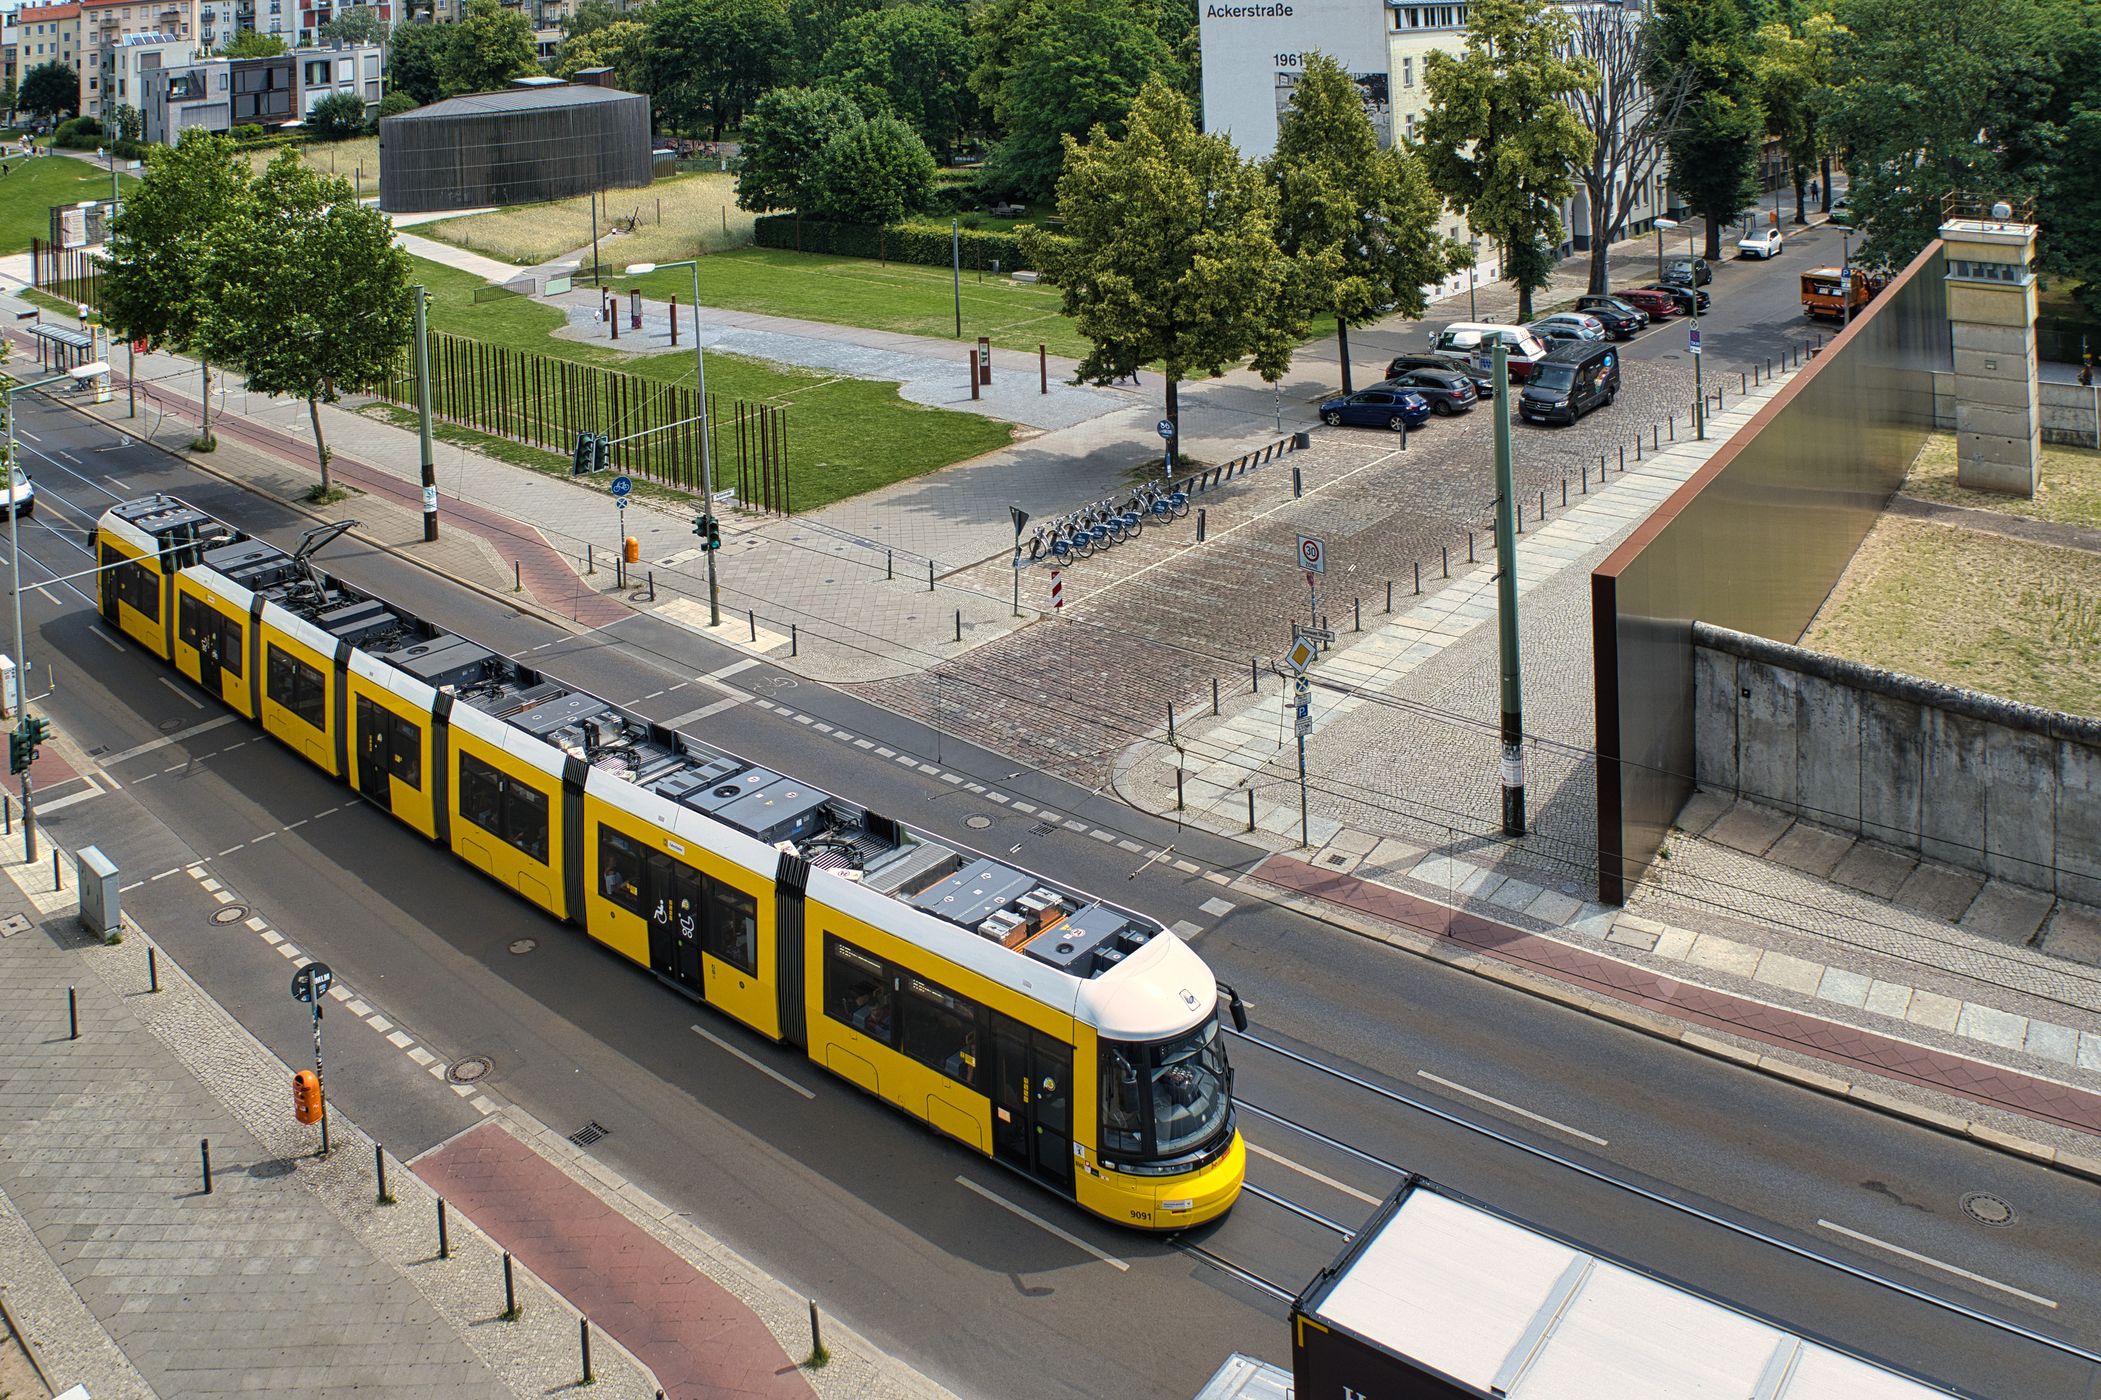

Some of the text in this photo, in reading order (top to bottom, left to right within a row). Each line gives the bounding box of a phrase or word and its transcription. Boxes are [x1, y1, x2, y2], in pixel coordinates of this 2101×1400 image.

[1207, 3, 1293, 18] Ackerstraße
[1273, 54, 1303, 67] 1961
[1305, 545, 1316, 557] 30
[1299, 706, 1307, 717] P
[1130, 1210, 1152, 1221] 9091
